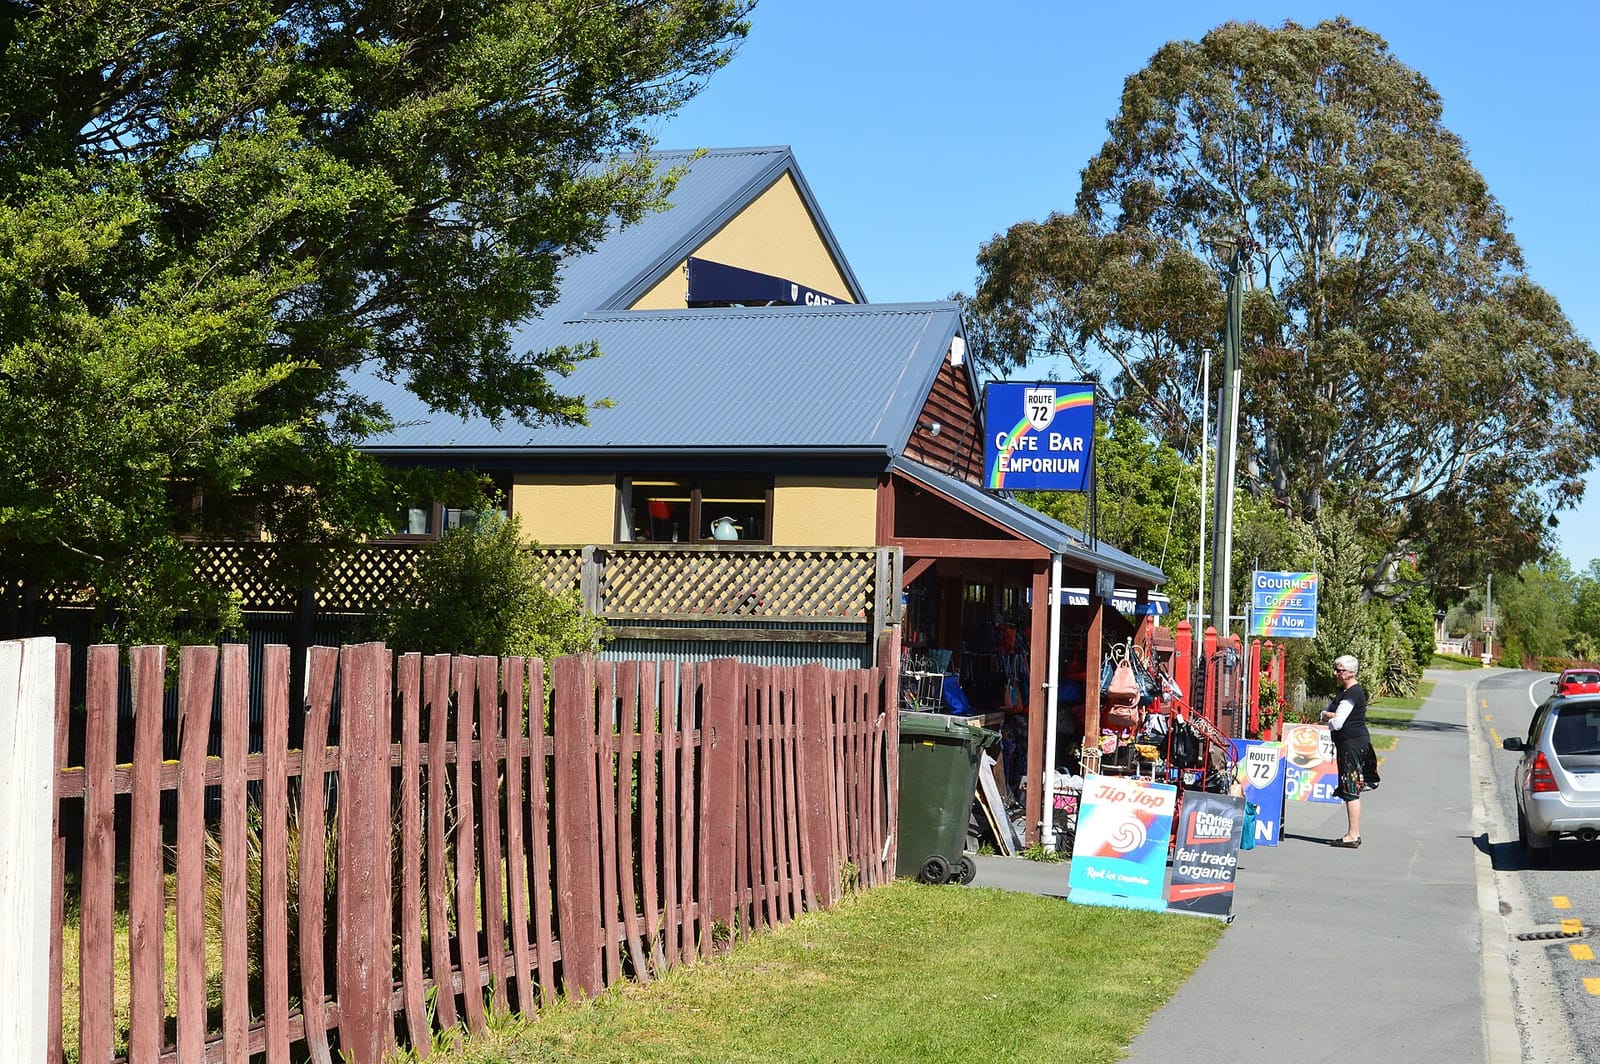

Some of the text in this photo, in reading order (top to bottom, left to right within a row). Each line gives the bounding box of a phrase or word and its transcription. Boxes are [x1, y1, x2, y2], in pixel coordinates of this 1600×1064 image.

[1028, 395, 1052, 404] ROUTE
[1032, 406, 1048, 421] 72
[995, 432, 1084, 451] CAFE BAR
[998, 454, 1080, 473] EMPORIUM
[1257, 576, 1314, 589] GOURMET
[1264, 595, 1303, 607] COFFEE
[1263, 616, 1305, 627] ON NOW
[1249, 752, 1275, 762] ROUTE
[1252, 764, 1270, 779] 72
[1286, 768, 1313, 779] CAFE
[1095, 785, 1165, 808] Tip Top
[1176, 848, 1237, 867] fair trade
[1178, 865, 1231, 880] organic
